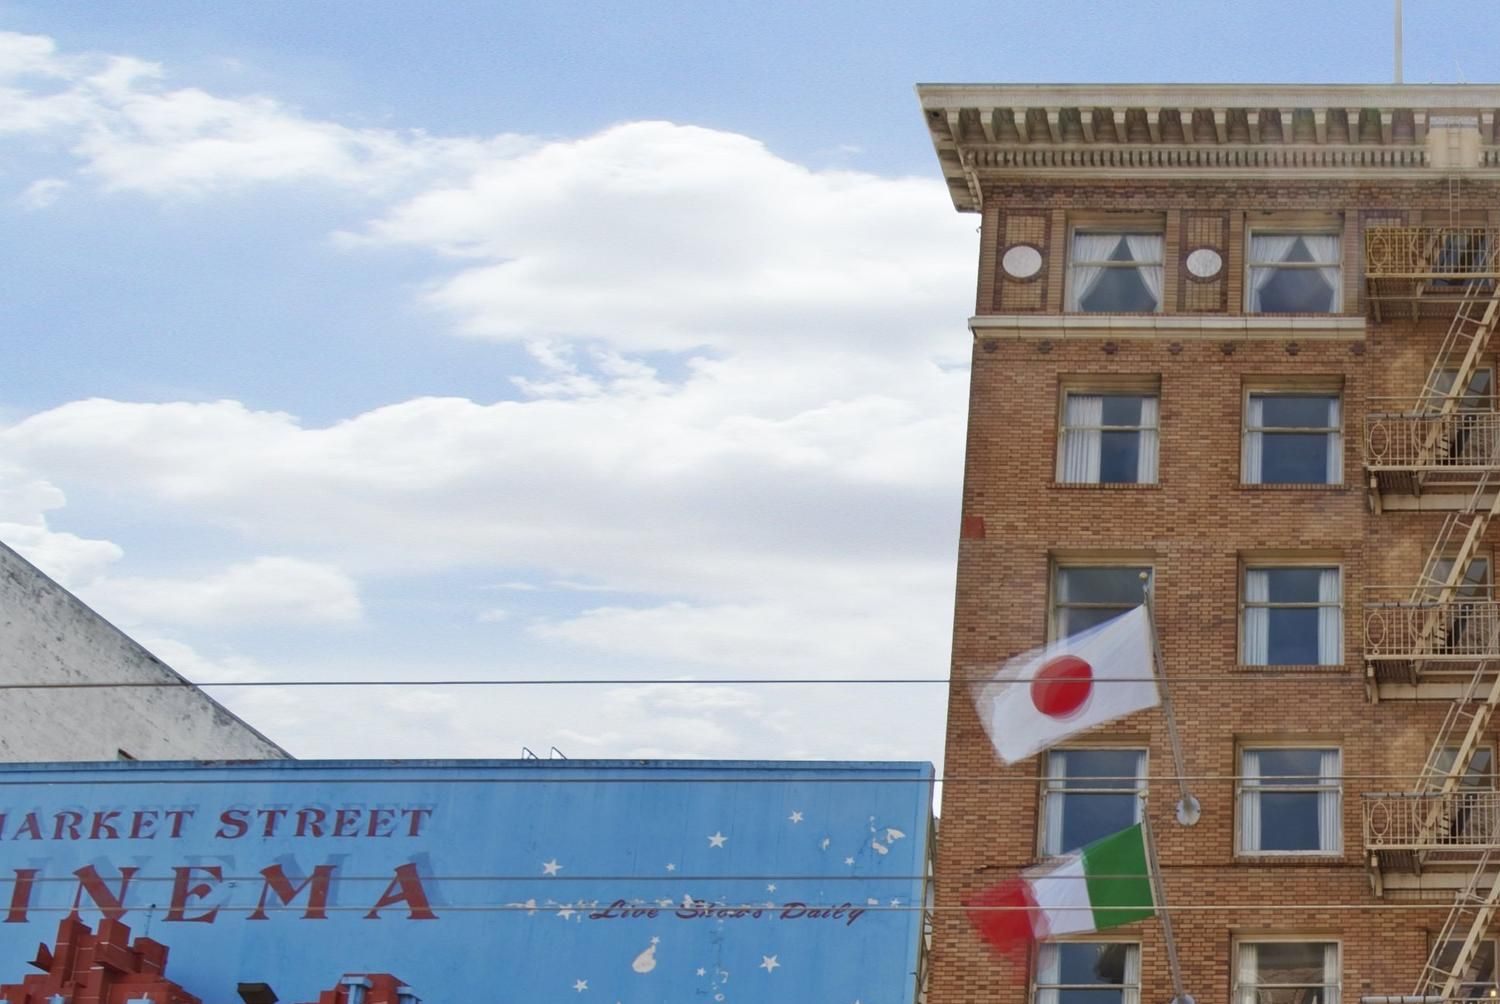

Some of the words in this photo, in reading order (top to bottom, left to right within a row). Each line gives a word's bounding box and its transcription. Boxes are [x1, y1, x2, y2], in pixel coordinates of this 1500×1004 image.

[214, 808, 433, 839] STREET
[588, 899, 659, 920] Live
[675, 900, 763, 919] Shows
[779, 902, 865, 926] Daily
